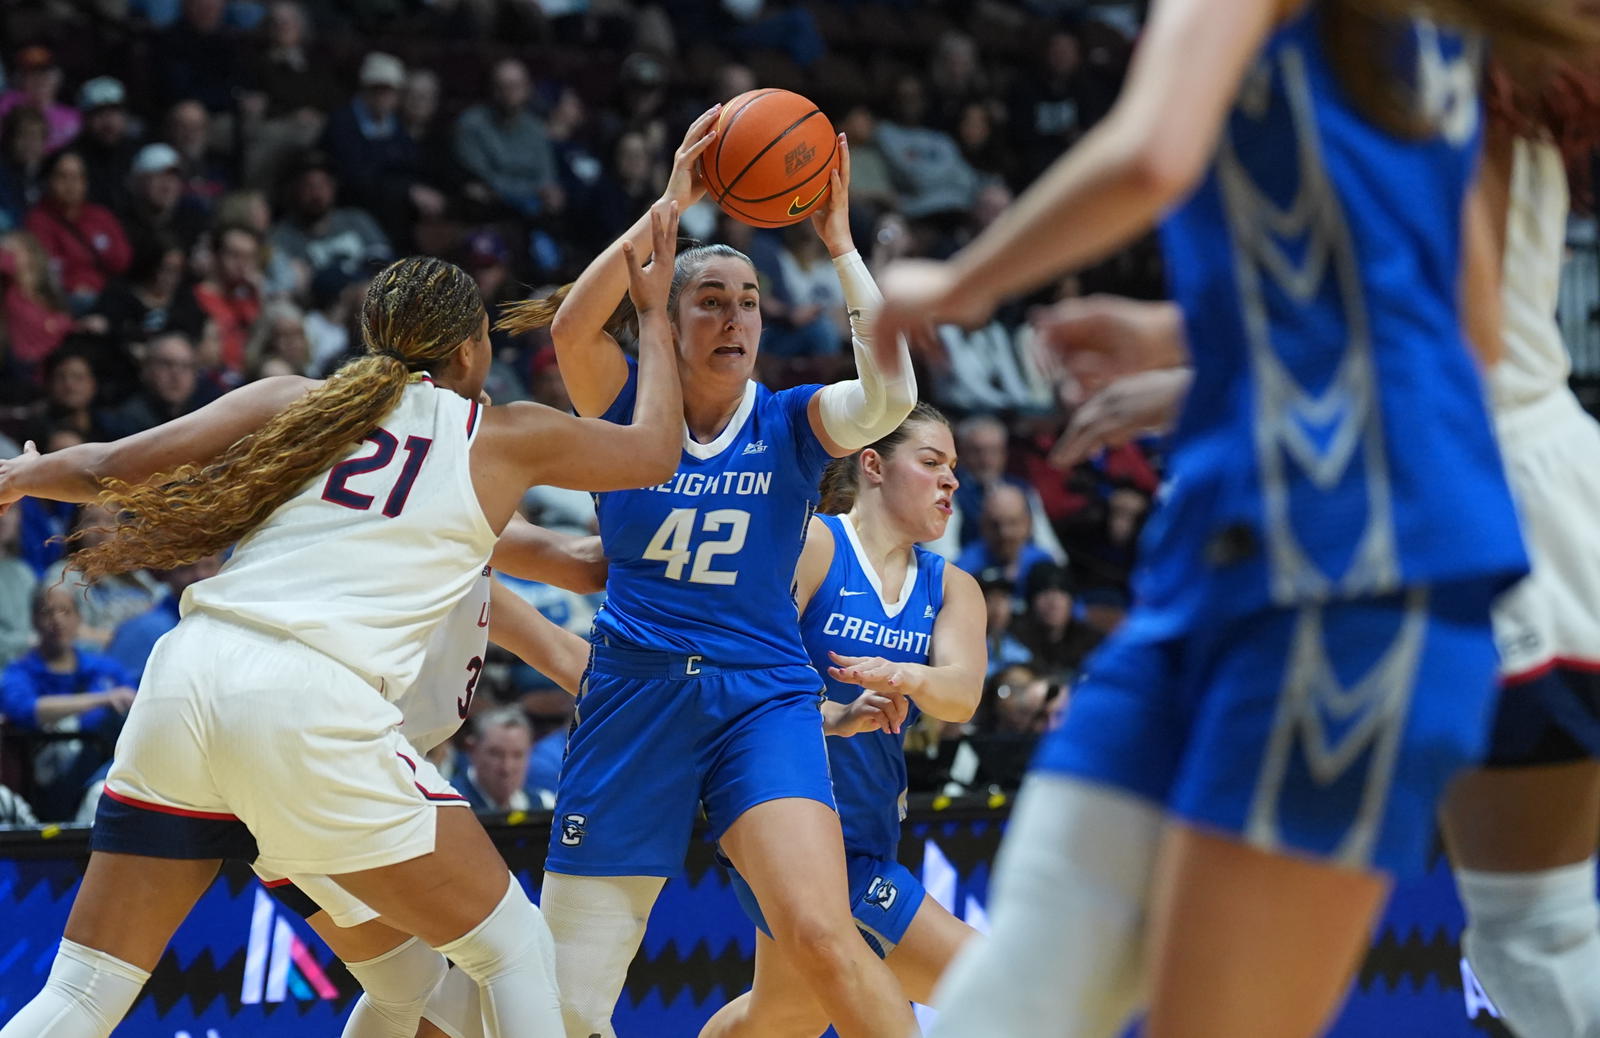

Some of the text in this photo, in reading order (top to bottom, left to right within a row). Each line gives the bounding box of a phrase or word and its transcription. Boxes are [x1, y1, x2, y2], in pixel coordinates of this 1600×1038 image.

[321, 427, 432, 518] 21
[642, 508, 751, 585] 42
[686, 655, 702, 675] C
